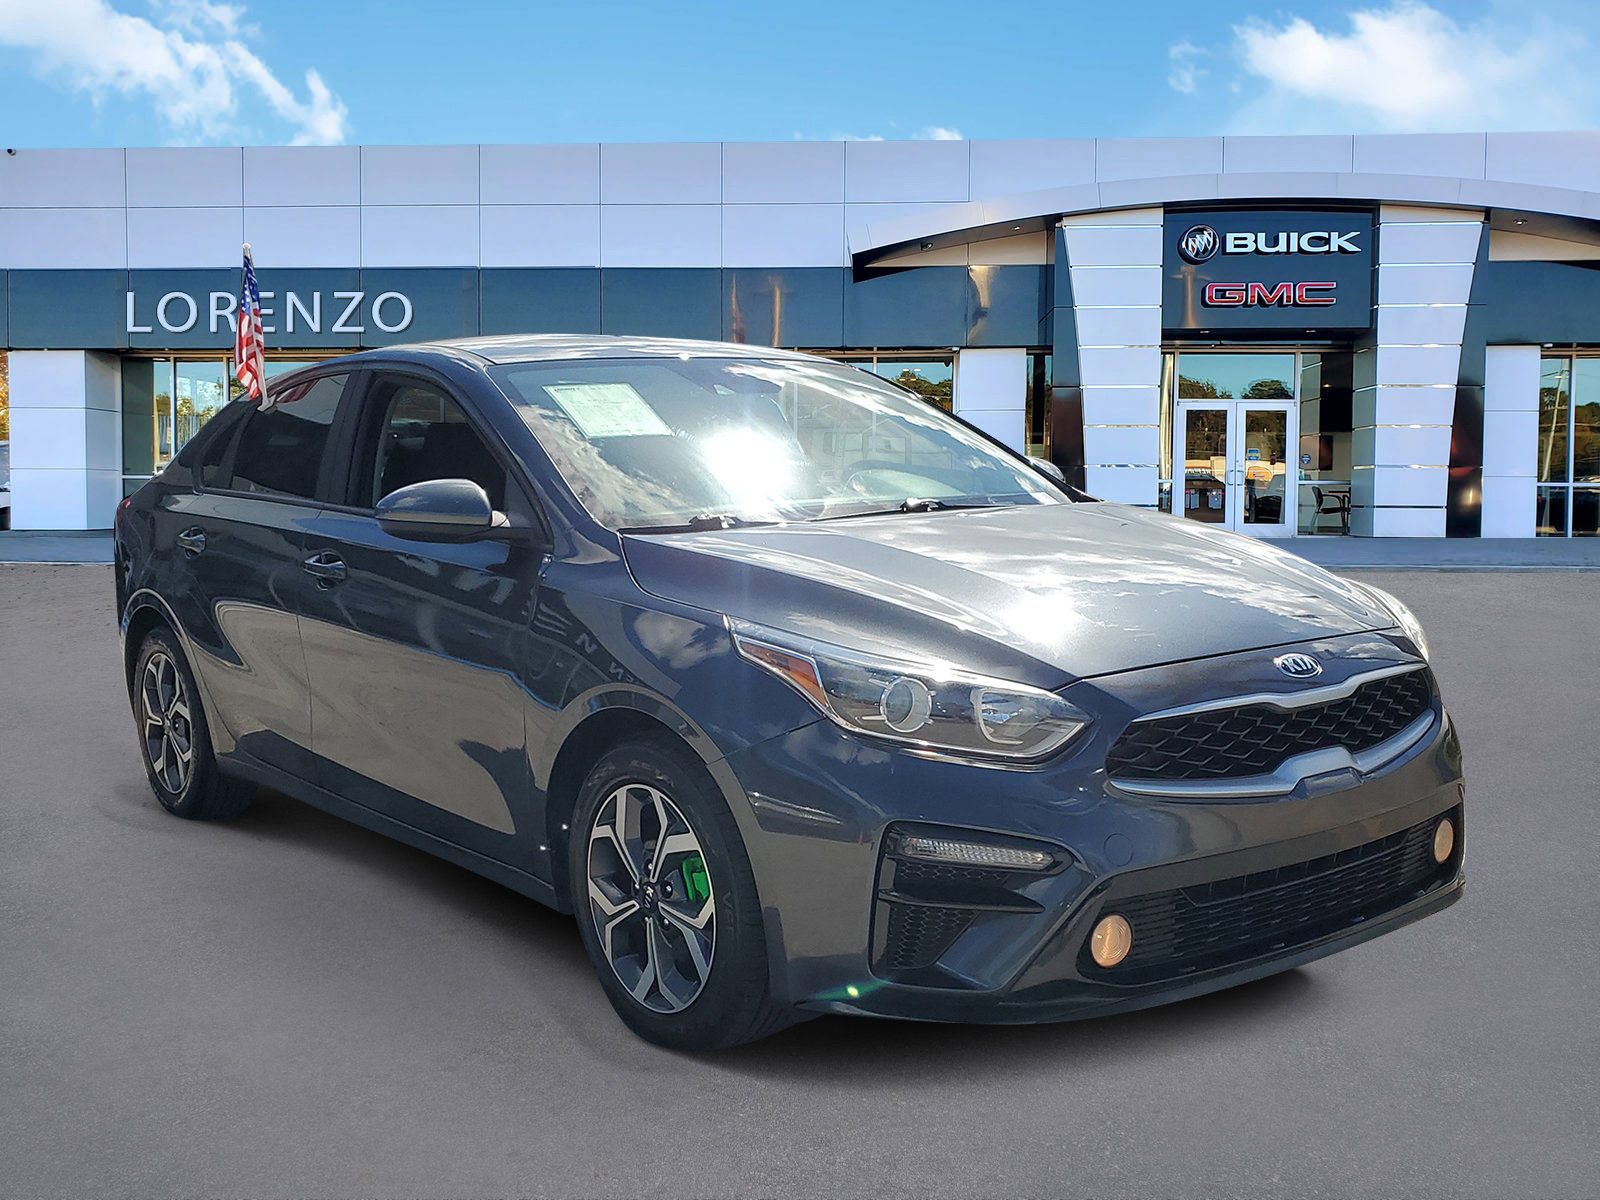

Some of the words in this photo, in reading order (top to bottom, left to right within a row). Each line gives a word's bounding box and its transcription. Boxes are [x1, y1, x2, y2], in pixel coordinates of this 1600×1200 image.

[1225, 231, 1362, 254] BUICK
[1204, 281, 1337, 305] GMC
[126, 291, 413, 333] LORENZO
[1281, 655, 1318, 673] KIA
